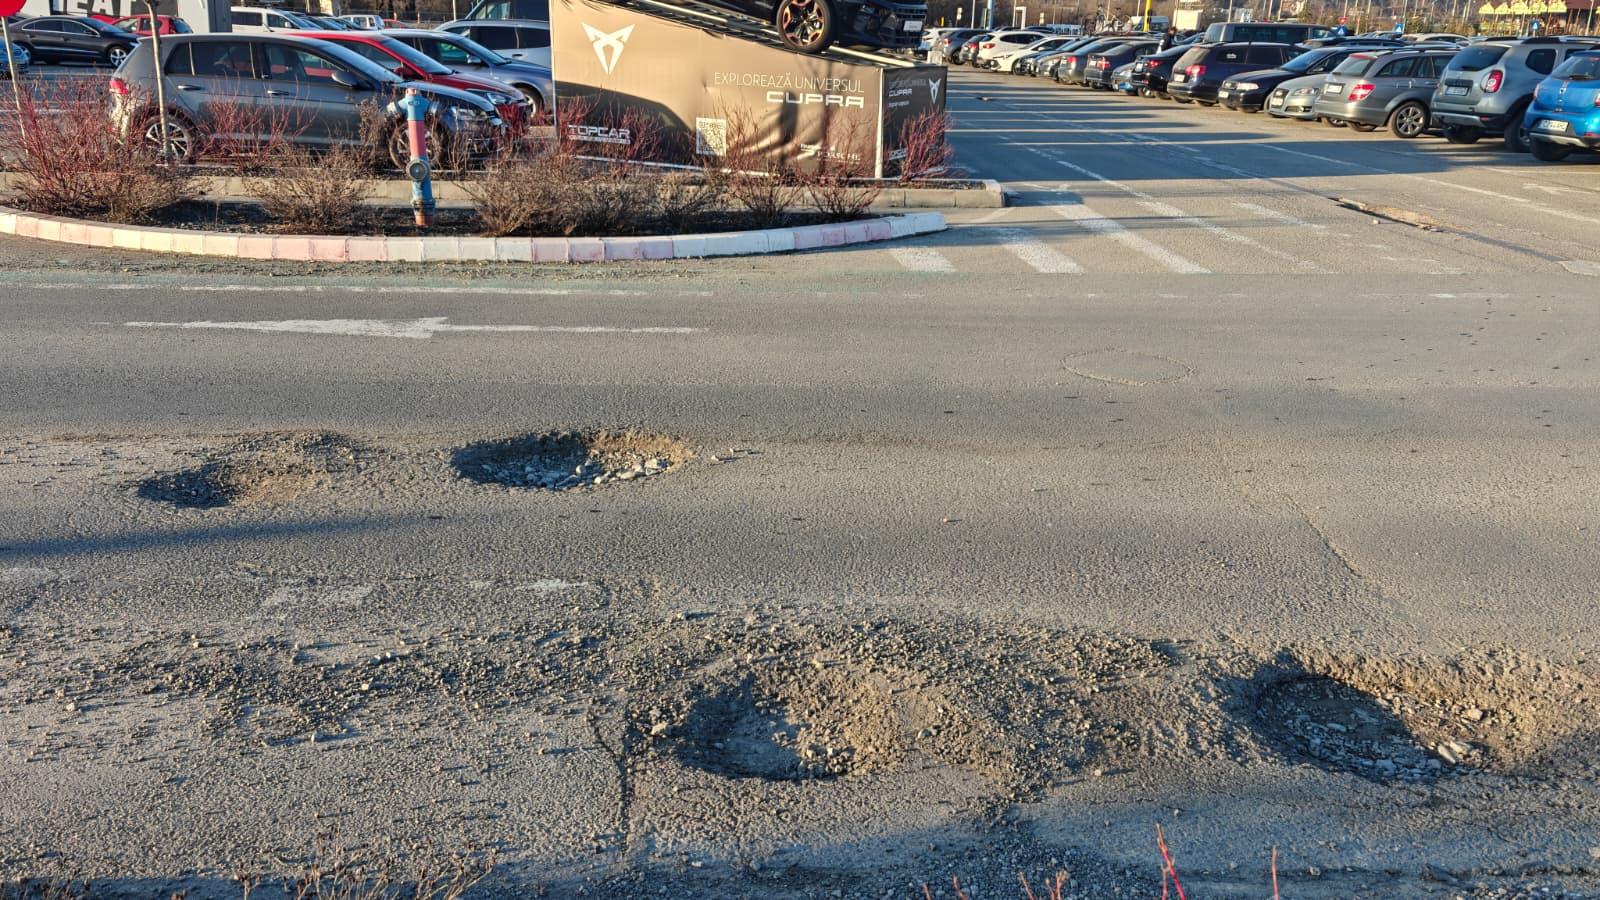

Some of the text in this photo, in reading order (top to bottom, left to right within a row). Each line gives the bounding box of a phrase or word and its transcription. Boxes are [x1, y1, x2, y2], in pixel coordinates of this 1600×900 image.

[714, 72, 865, 93] EXPLOREAZĂ UNIVERSUL
[766, 91, 865, 109] CUPRA
[567, 124, 631, 140] TOPCAR
